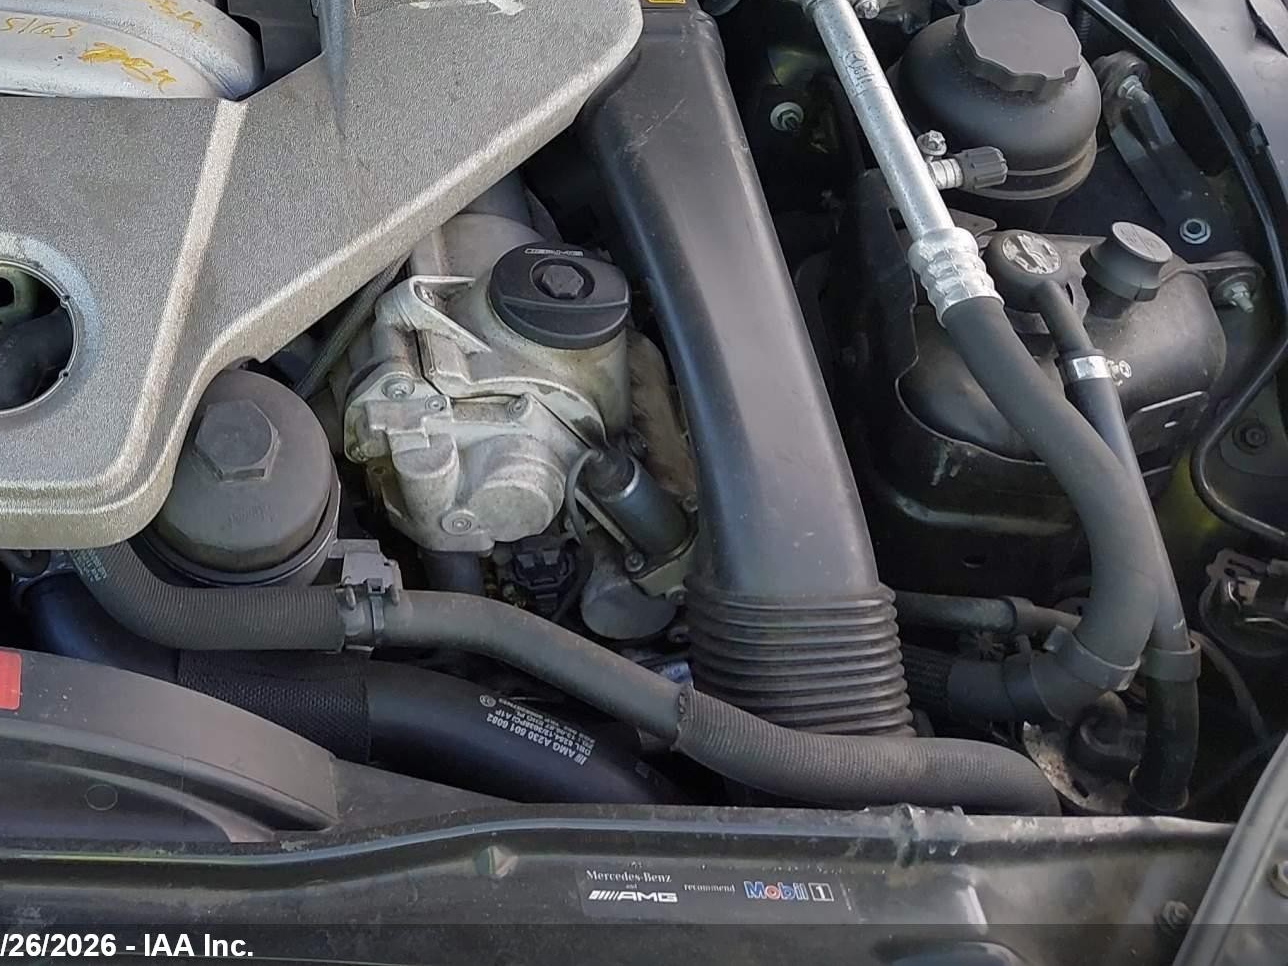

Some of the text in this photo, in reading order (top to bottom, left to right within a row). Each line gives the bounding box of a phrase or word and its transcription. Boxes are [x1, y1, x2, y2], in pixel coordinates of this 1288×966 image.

[528, 731, 552, 747] A230
[552, 743, 576, 759] AMG
[586, 870, 672, 883] Mercedes-Benz
[683, 883, 735, 894] recommend
[743, 881, 809, 902] Mobil
